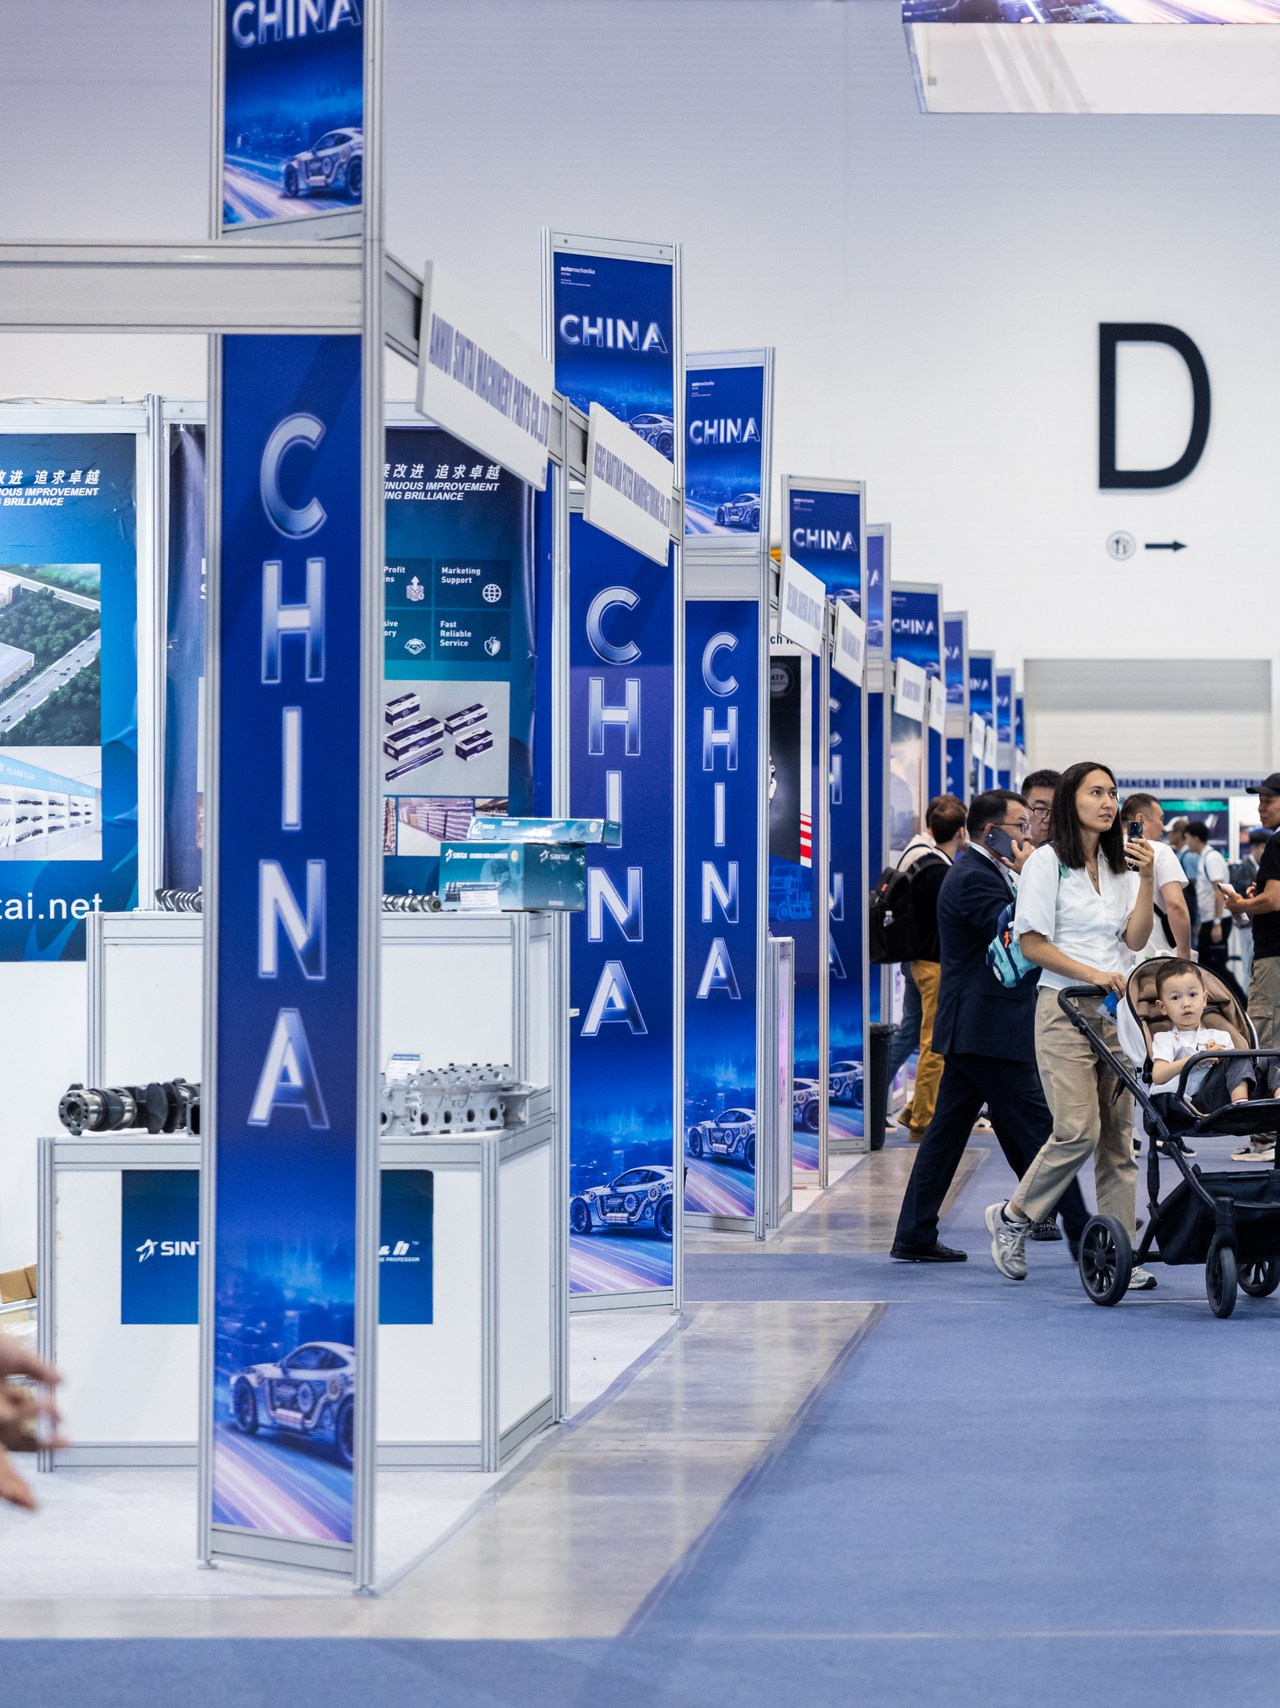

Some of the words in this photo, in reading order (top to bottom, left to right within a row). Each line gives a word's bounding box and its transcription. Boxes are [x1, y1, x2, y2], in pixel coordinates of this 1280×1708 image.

[232, 0, 362, 48] CHINA
[560, 313, 668, 354] CHINA
[1097, 322, 1213, 488] D
[689, 416, 761, 445] CHINA
[34, 469, 100, 485] 追求卓越
[435, 464, 500, 480] 追求卓越
[0, 487, 22, 496] OUS
[25, 487, 99, 496] IMPROVEMENT
[425, 482, 500, 491] IMPROVEMENT
[3, 497, 64, 506] BRILLIANCE
[404, 491, 464, 500] BRILLIANCE
[792, 527, 857, 551] CHINA
[384, 566, 406, 574] Profit
[441, 567, 481, 576] Marketing
[441, 576, 472, 585] Support
[440, 620, 457, 628] Fast
[892, 618, 936, 636] CHINA
[440, 629, 472, 638] Reliable
[440, 639, 469, 647] Service
[247, 412, 331, 1129] CHINA
[580, 586, 648, 1036] CHINA
[696, 631, 741, 999] CHINA
